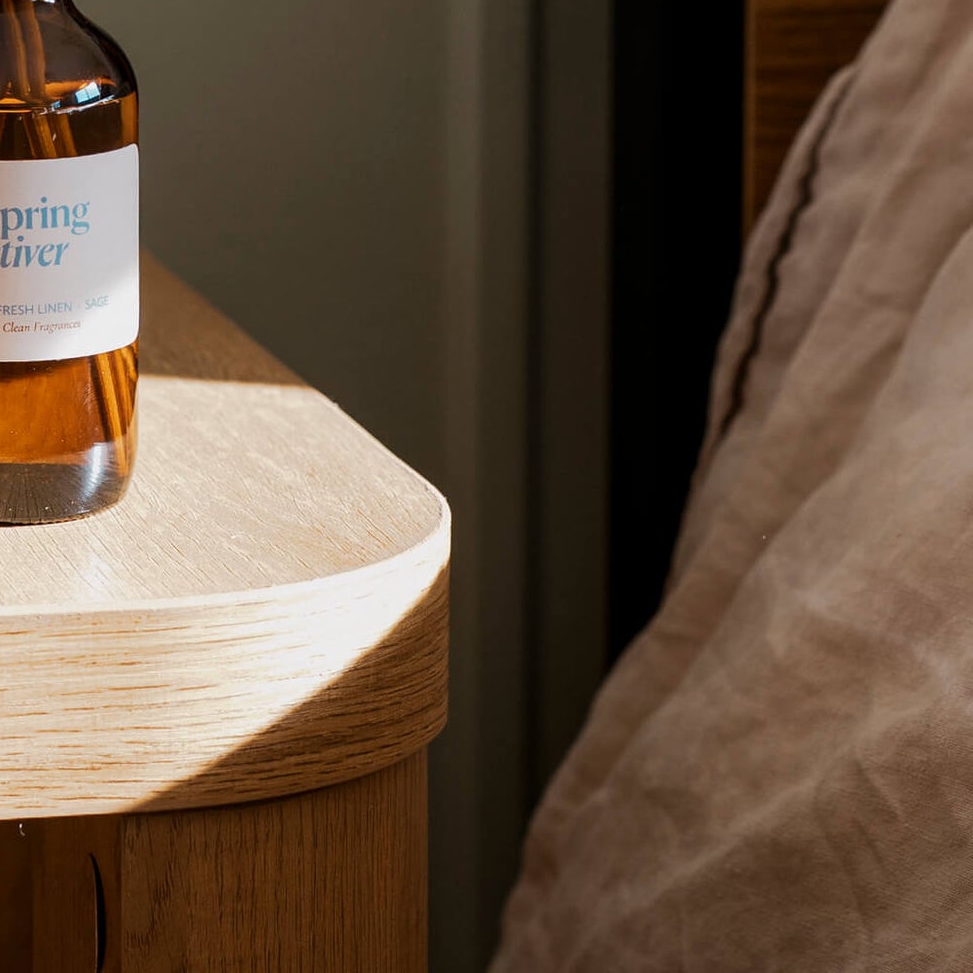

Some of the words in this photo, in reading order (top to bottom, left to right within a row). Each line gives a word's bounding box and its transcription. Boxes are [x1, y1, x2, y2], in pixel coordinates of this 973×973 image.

[37, 301, 73, 315] LINEN
[84, 295, 110, 311] SAGE
[2, 321, 30, 333] Clean
[33, 320, 81, 335] Fragrances
